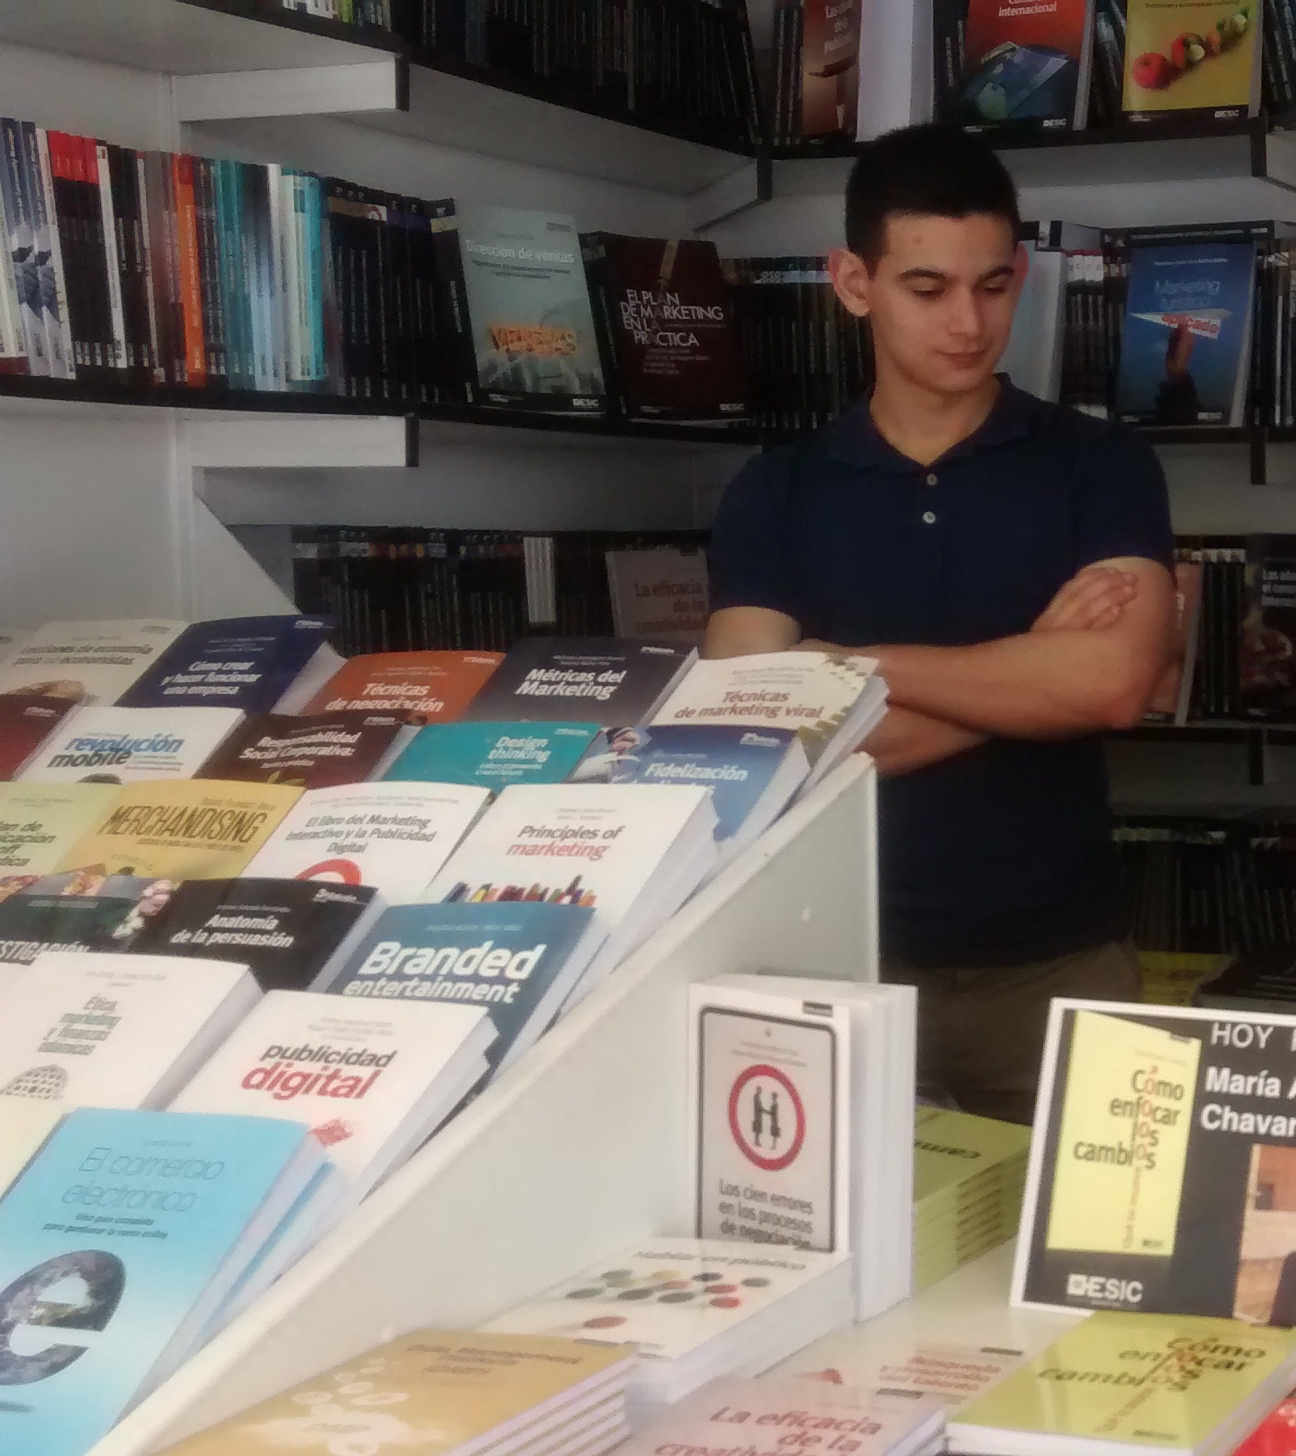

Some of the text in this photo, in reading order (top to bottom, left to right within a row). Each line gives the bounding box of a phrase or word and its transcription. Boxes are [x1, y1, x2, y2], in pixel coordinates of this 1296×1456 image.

[999, 1, 1057, 17] internacional
[466, 240, 515, 258] Dirección
[519, 248, 534, 260] de
[627, 289, 642, 304] EL
[620, 301, 638, 317] DE
[624, 318, 642, 330] EN
[525, 667, 627, 685] Métricas del
[362, 681, 430, 696] Técnicas
[514, 680, 619, 701] Marketing
[722, 690, 791, 703] Técnicas
[324, 697, 445, 712] de negociación
[674, 704, 824, 719] de marketing viral
[64, 733, 185, 755] revolución
[257, 730, 362, 748] Responsabilidad
[496, 736, 549, 751] Design
[46, 749, 133, 769] mobile
[239, 744, 355, 759] Social Corporativa:
[487, 747, 551, 763] thinking
[644, 762, 749, 781] Fidelización
[97, 805, 269, 844] MERCHANDISING
[305, 814, 432, 829] El libro del Marketing
[286, 828, 436, 844] Interactivo y la Publicidad
[518, 825, 624, 842] Principles of
[326, 841, 368, 855] Digital
[506, 841, 611, 861] marketing
[204, 914, 279, 930] Anatomía
[171, 929, 295, 949] de la persuasión
[356, 940, 548, 981] Branded
[343, 977, 521, 1004] entertainment
[1211, 1023, 1271, 1050] HOY
[259, 1043, 398, 1069] publicidad
[240, 1061, 382, 1102] digital
[1132, 1066, 1184, 1100] Cómo
[1205, 1066, 1281, 1099] María
[1110, 1096, 1181, 1126] enfocar
[79, 1146, 225, 1181] El comercio
[1073, 1141, 1156, 1169] cambios
[62, 1180, 198, 1212] electrónico
[719, 1179, 814, 1214] Los cien errores
[719, 1201, 814, 1235] en los procesos
[720, 1219, 737, 1235] de
[1087, 1275, 1144, 1302] ESIC
[709, 1406, 885, 1436] La eficacia
[778, 1429, 862, 1452] de la
